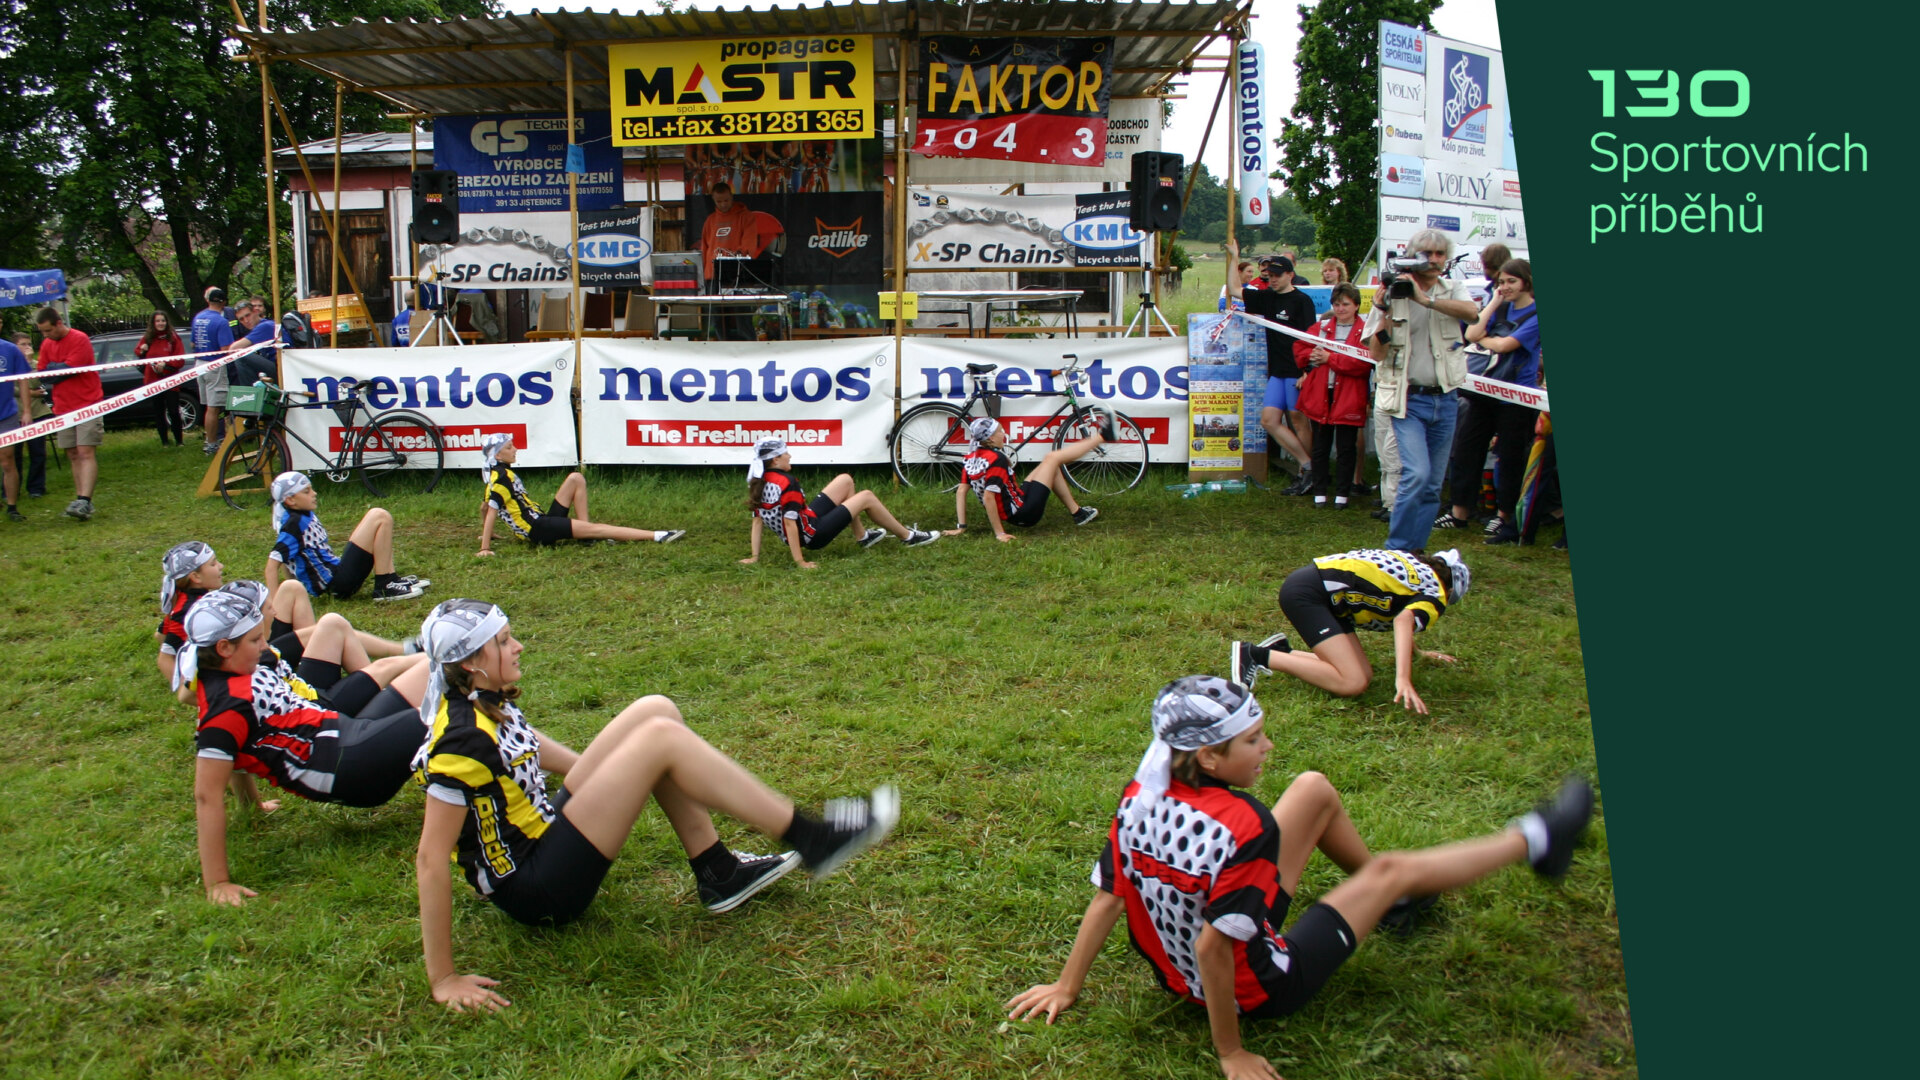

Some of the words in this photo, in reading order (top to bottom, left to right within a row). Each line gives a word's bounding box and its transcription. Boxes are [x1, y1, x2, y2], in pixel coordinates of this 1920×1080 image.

[929, 41, 1105, 57] RADIO
[1385, 29, 1413, 51] ČESKÁ
[720, 38, 855, 62] propagace
[1385, 47, 1422, 65] SPOŘITELNA
[624, 60, 856, 107] MASTR
[927, 61, 1103, 114] FAKTOR
[1386, 81, 1421, 101] VOLNÝ
[676, 104, 697, 114] spol.
[708, 104, 721, 112] r.o.
[1240, 48, 1263, 172] mentos
[525, 119, 582, 130] TECHNK
[815, 110, 861, 132] 365
[1107, 119, 1149, 129] OOBCHOD
[470, 120, 529, 156] GS
[924, 122, 1096, 159] 104.3
[1394, 128, 1423, 141] Rubena
[1104, 151, 1123, 159] ec.cz
[1441, 140, 1456, 152] Kolo
[1457, 145, 1468, 155] pro
[493, 156, 563, 171] VÝROBCE
[457, 172, 544, 187] EREZOVÉHO
[1436, 171, 1492, 201] VOLNÝ
[495, 199, 508, 207] 391
[519, 198, 562, 206] JISTEBNICE
[1099, 201, 1115, 211] the
[1116, 199, 1131, 209] bes
[600, 219, 615, 228] the
[1074, 223, 1142, 242] KMC
[808, 230, 868, 248] catlike
[578, 240, 641, 258] KMC
[913, 242, 971, 263] X-SP
[978, 243, 1065, 265] Chains
[1077, 255, 1110, 265] bicycle
[1113, 255, 1139, 264] chain
[487, 262, 569, 283] Chains
[580, 272, 613, 281] bicycle
[19, 285, 44, 296] Team
[302, 366, 554, 410] mentos
[600, 360, 871, 403] mentos
[921, 358, 1189, 401] mentos
[638, 424, 682, 444] The
[686, 424, 830, 444] Freshmaker
[1010, 420, 1155, 442] Freshmker
